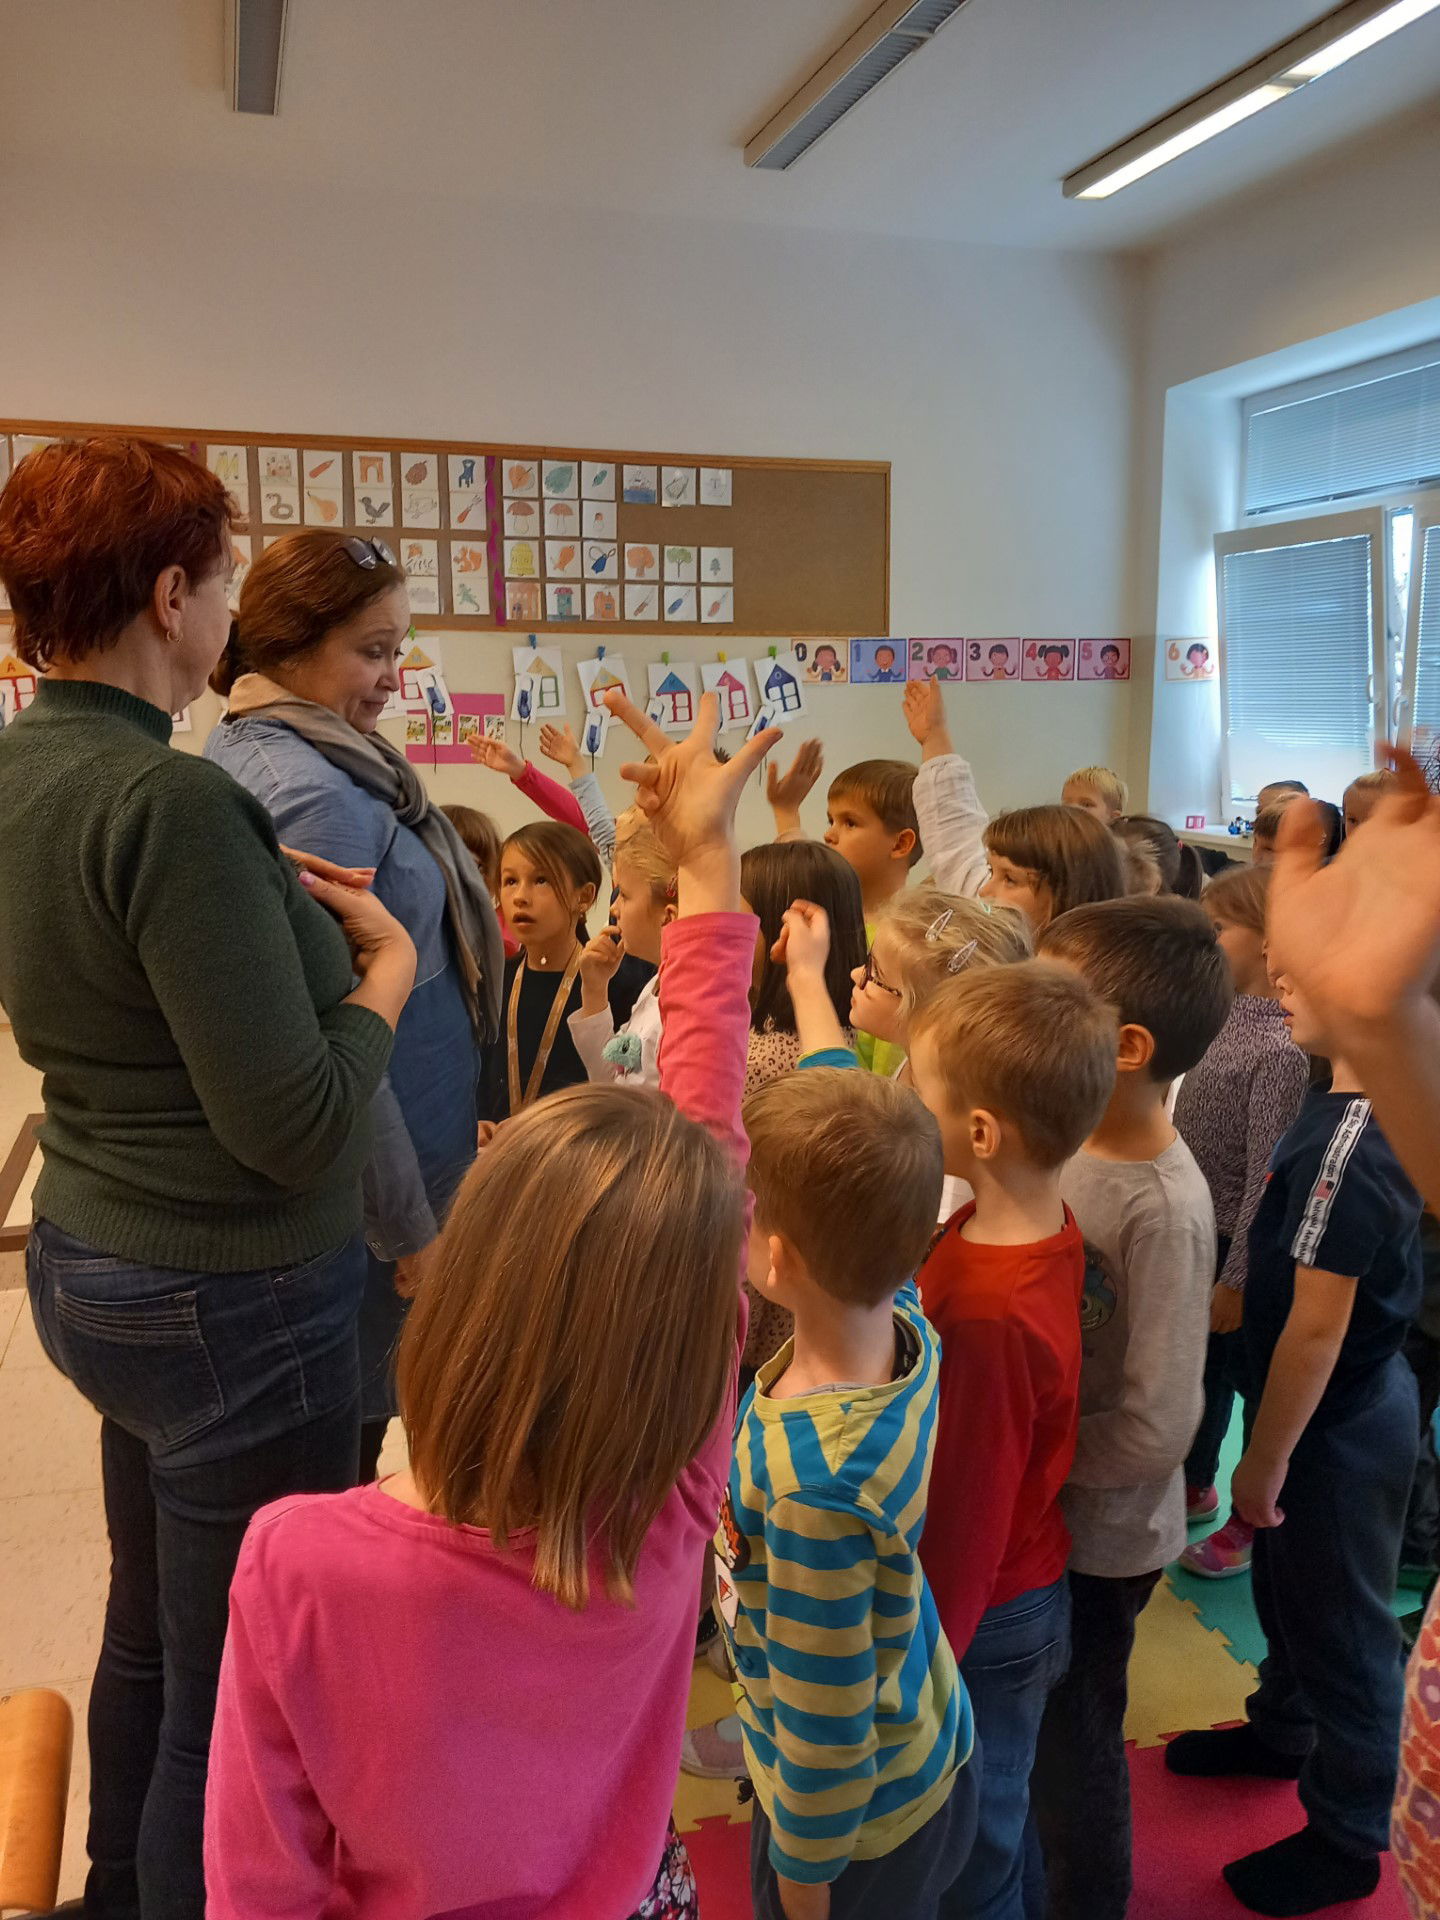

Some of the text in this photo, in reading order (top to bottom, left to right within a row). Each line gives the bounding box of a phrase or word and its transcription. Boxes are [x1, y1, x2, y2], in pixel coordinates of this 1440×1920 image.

[794, 642, 808, 662] 0
[854, 643, 861, 662] 1
[911, 642, 924, 661] 2
[969, 642, 981, 661] 3
[1025, 642, 1037, 661] 4
[1081, 642, 1093, 660] 5
[1168, 643, 1180, 661] 6
